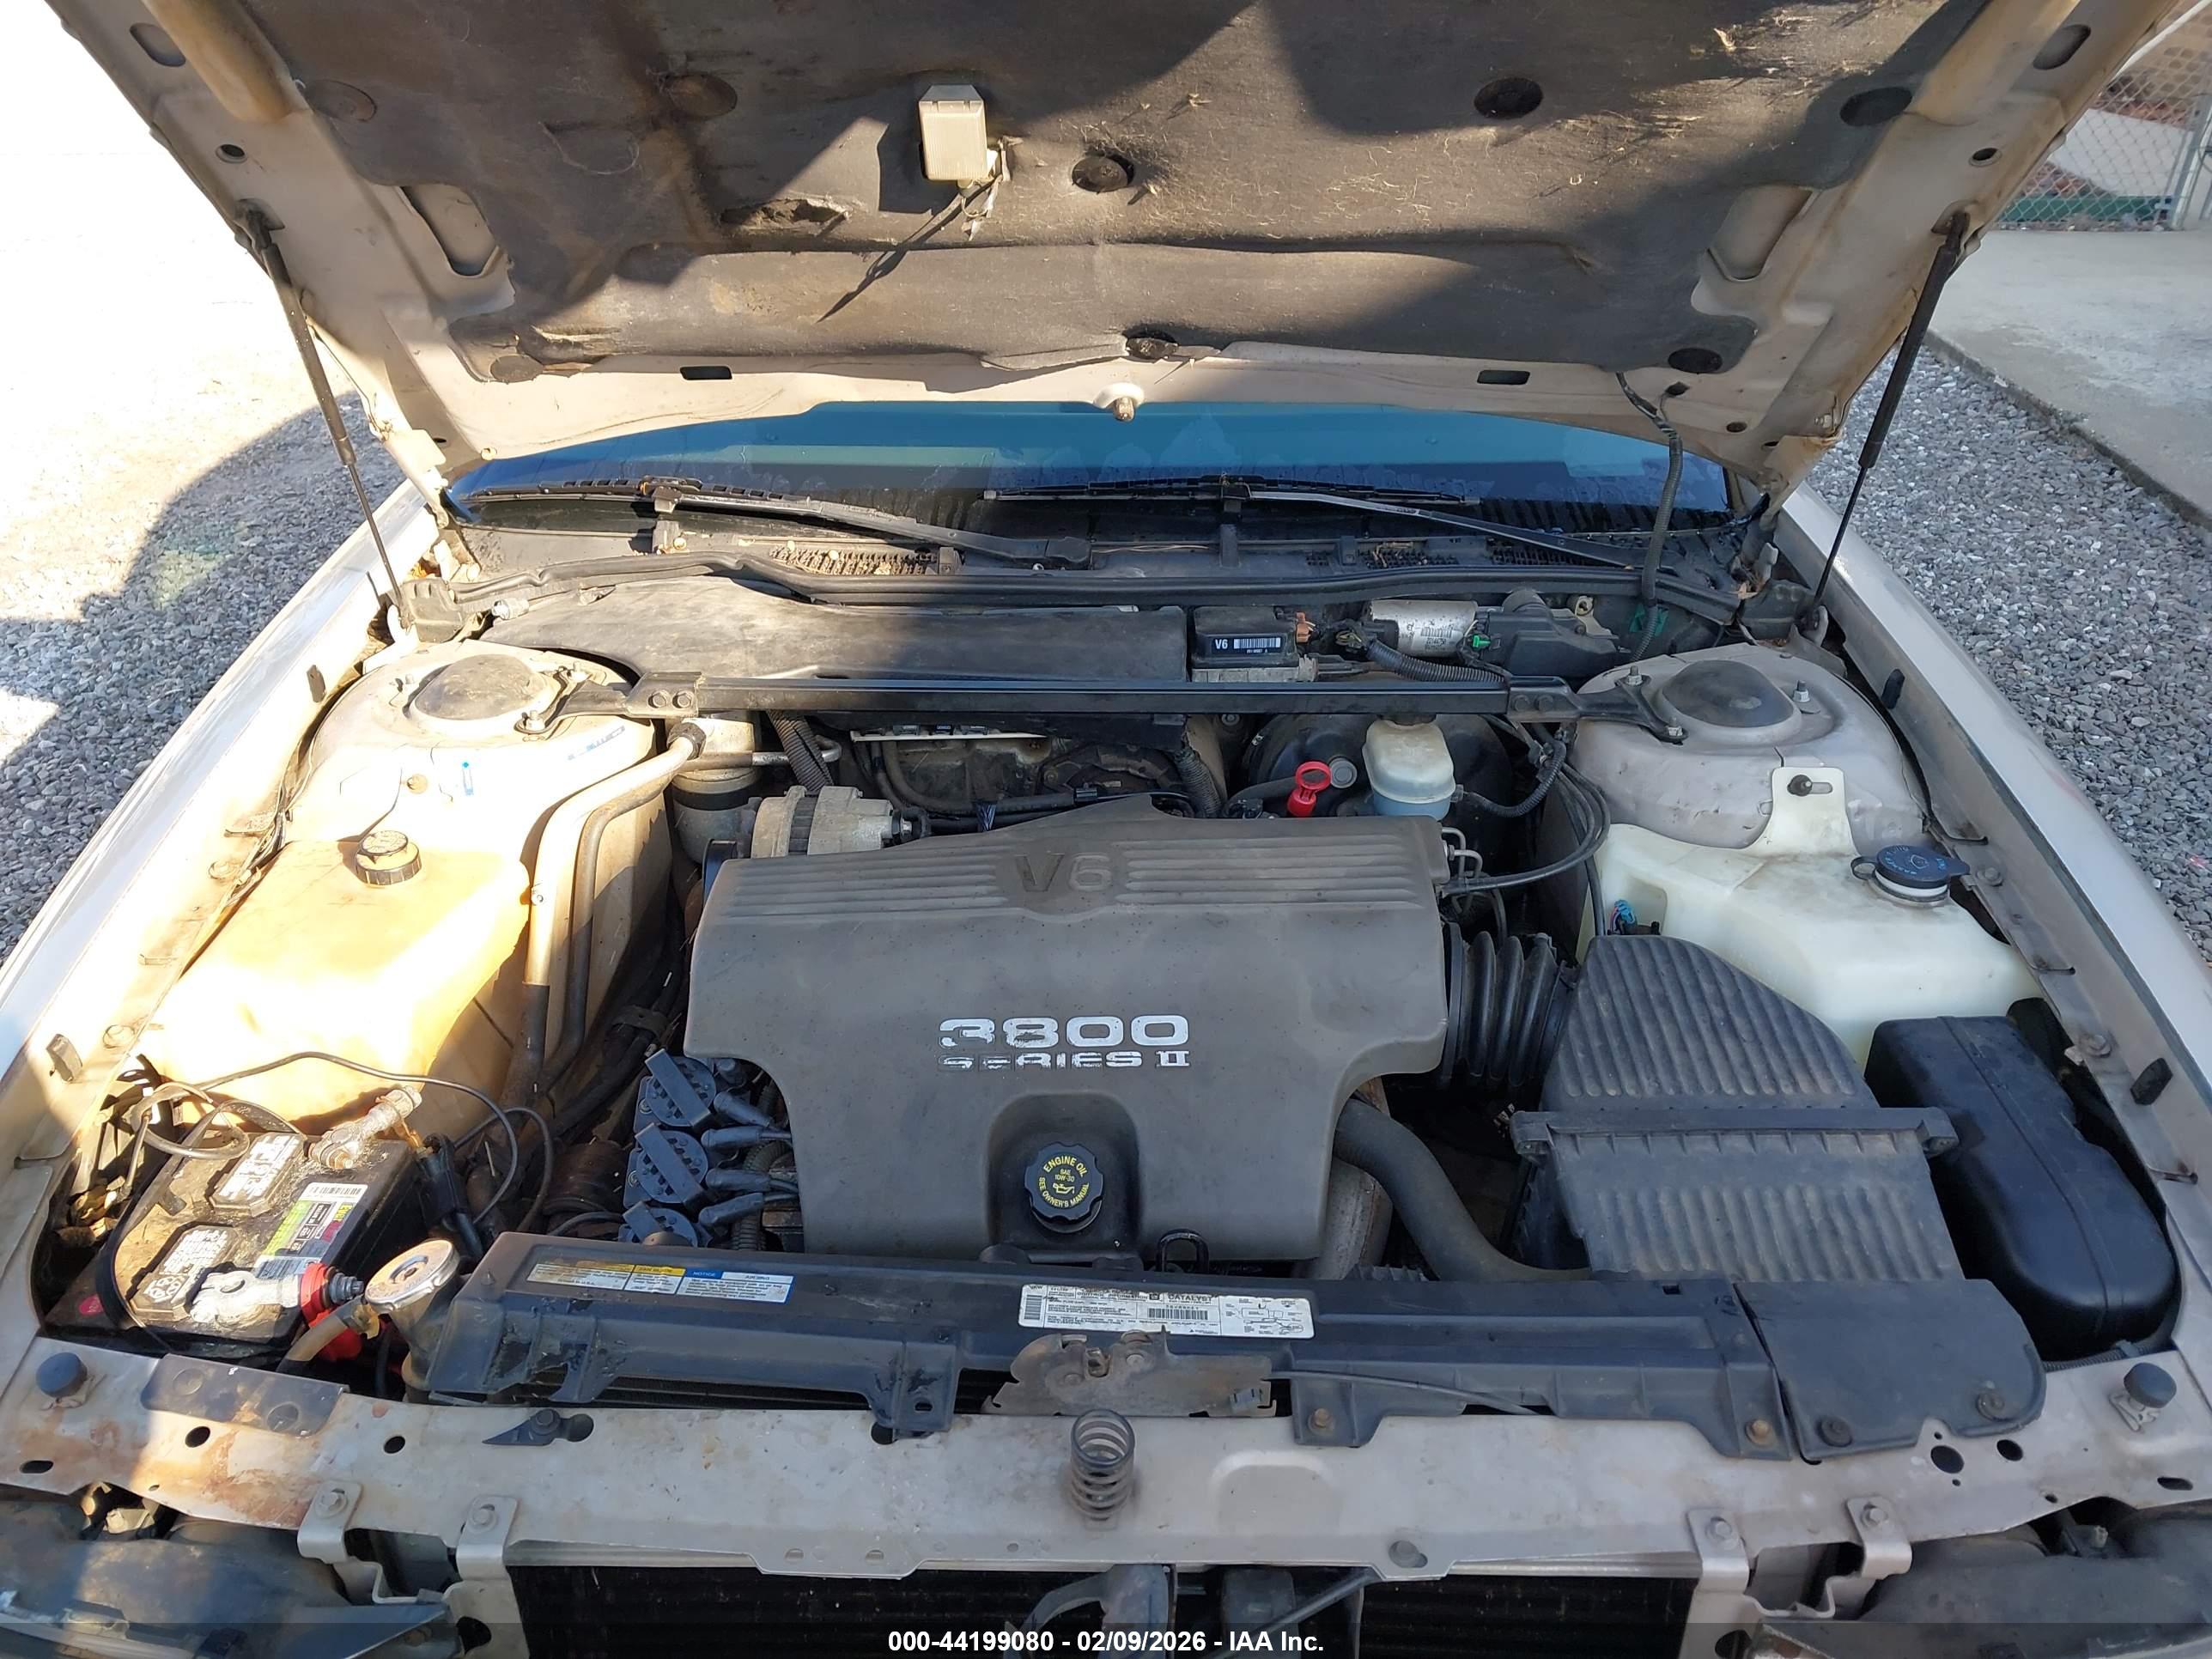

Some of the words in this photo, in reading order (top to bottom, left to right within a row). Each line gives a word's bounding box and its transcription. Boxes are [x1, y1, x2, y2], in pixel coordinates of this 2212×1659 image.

[1214, 638, 1229, 650] V6
[1014, 852, 1112, 893] V6
[938, 1015, 1189, 1048] 3800
[938, 1050, 1143, 1071] SERIES
[1043, 1156, 1077, 1173] ENGINE
[1076, 1162, 1088, 1177] OIL
[1054, 1174, 1075, 1182] 10W-30
[1042, 1190, 1069, 1207] OWNER'S
[1070, 1182, 1090, 1206] MANUAL
[1168, 1293, 1212, 1302] CATALYST
